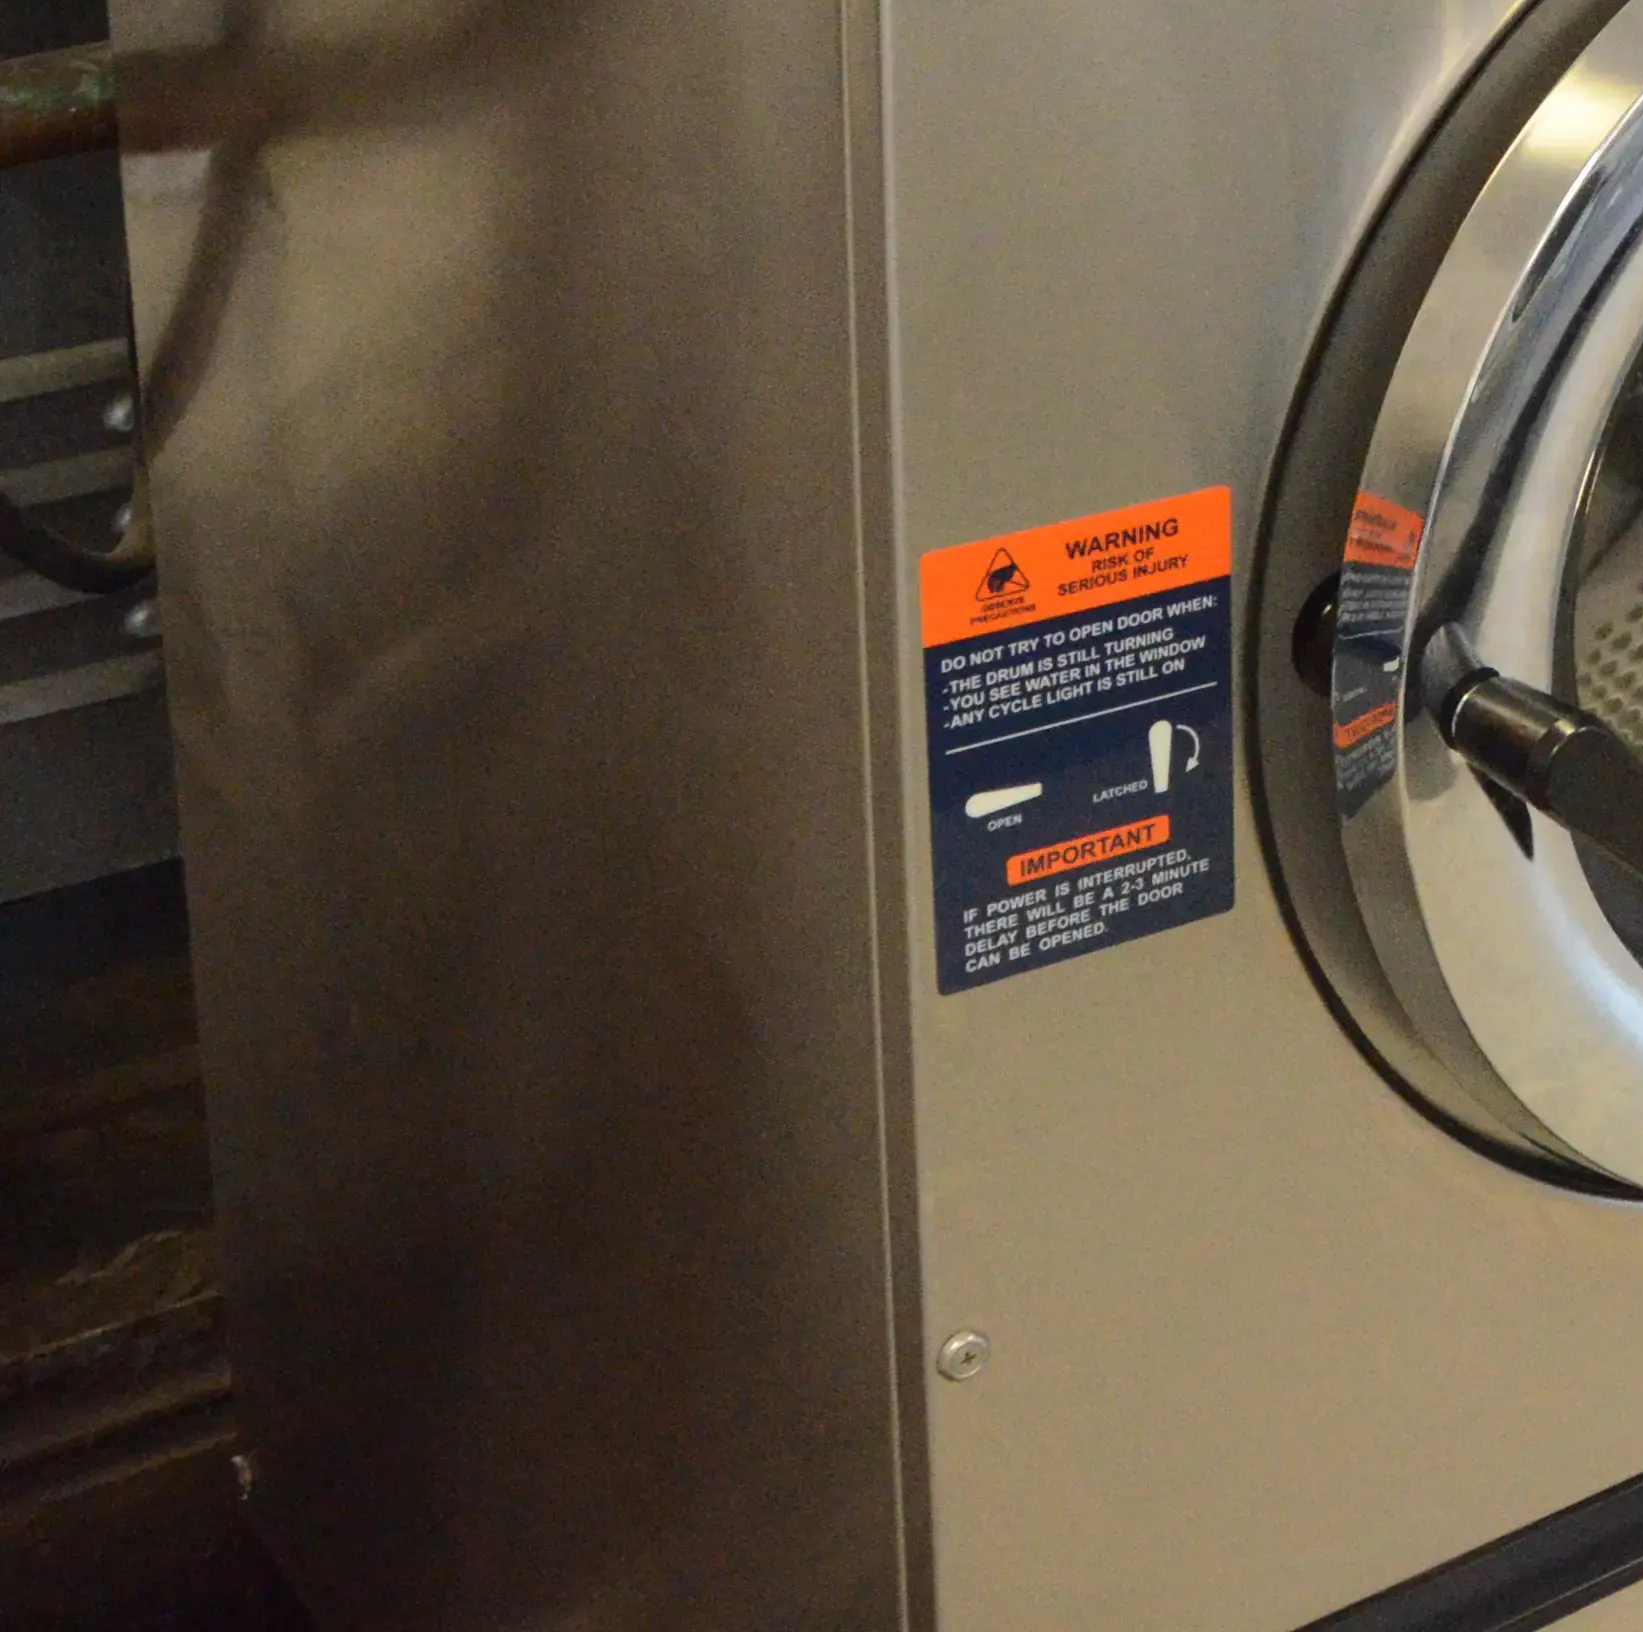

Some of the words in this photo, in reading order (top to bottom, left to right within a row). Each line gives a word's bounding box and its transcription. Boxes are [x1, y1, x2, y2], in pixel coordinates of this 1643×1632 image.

[1066, 519, 1178, 558] WARNING
[1058, 569, 1127, 596] SERIOUS
[1133, 555, 1187, 578] INJURY
[1092, 554, 1128, 572] RISK
[1134, 547, 1153, 563] OF
[941, 655, 966, 673] DO
[970, 646, 1003, 665] NOT
[1009, 638, 1039, 656] TRY
[1044, 631, 1065, 647] TO
[1069, 620, 1113, 641] OPEN
[1118, 608, 1162, 629] DOOR
[1167, 595, 1218, 617] WHEN:
[944, 675, 980, 693] -THE
[986, 662, 1033, 685] DRUM
[1038, 657, 1053, 672] IS
[1058, 648, 1099, 668] STILL
[1105, 629, 1173, 654] TURNING
[1093, 779, 1148, 803] LATCHED
[988, 814, 1022, 831] OPEN
[1021, 824, 1160, 875] IMPORTANT
